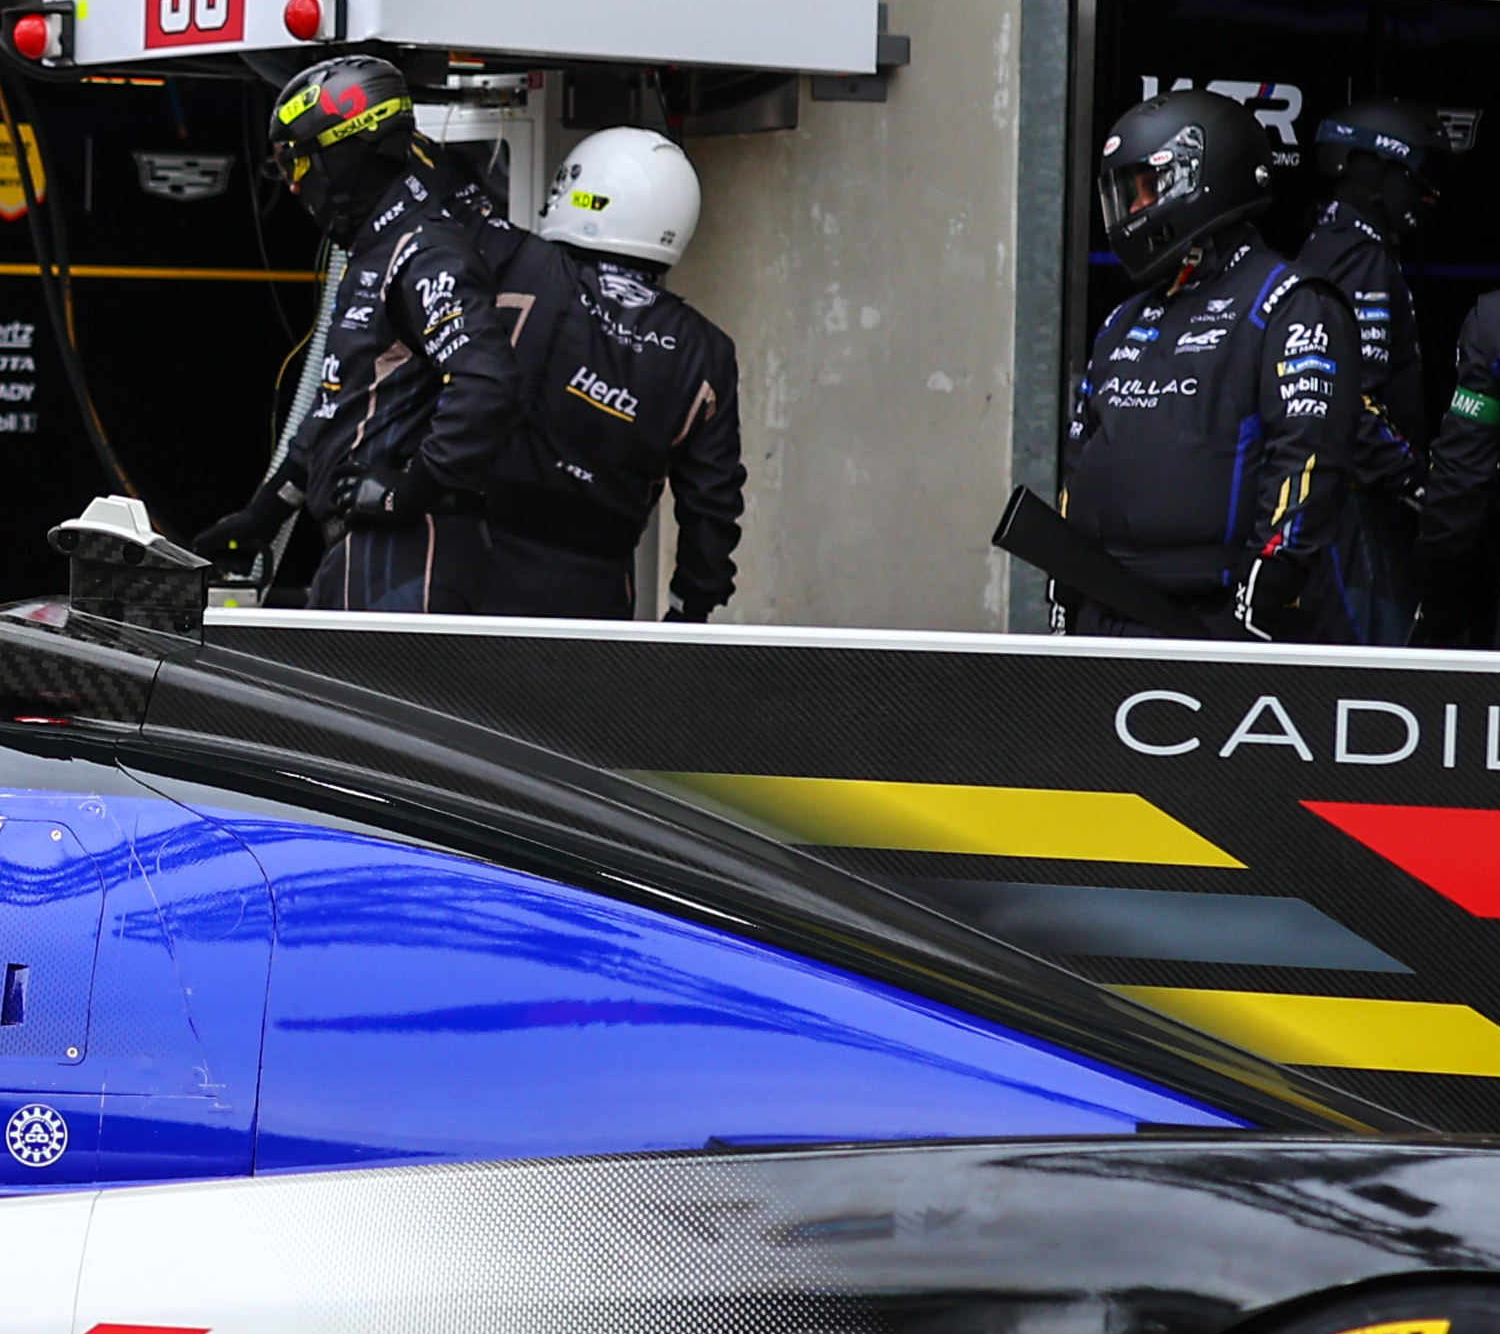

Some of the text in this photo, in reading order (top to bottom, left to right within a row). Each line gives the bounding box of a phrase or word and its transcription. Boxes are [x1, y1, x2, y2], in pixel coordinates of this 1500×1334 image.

[1375, 134, 1411, 156] WTR
[1285, 322, 1329, 347] 24h
[570, 365, 640, 417] Hertz
[1280, 377, 1318, 401] Mobil
[1286, 398, 1328, 415] WTR
